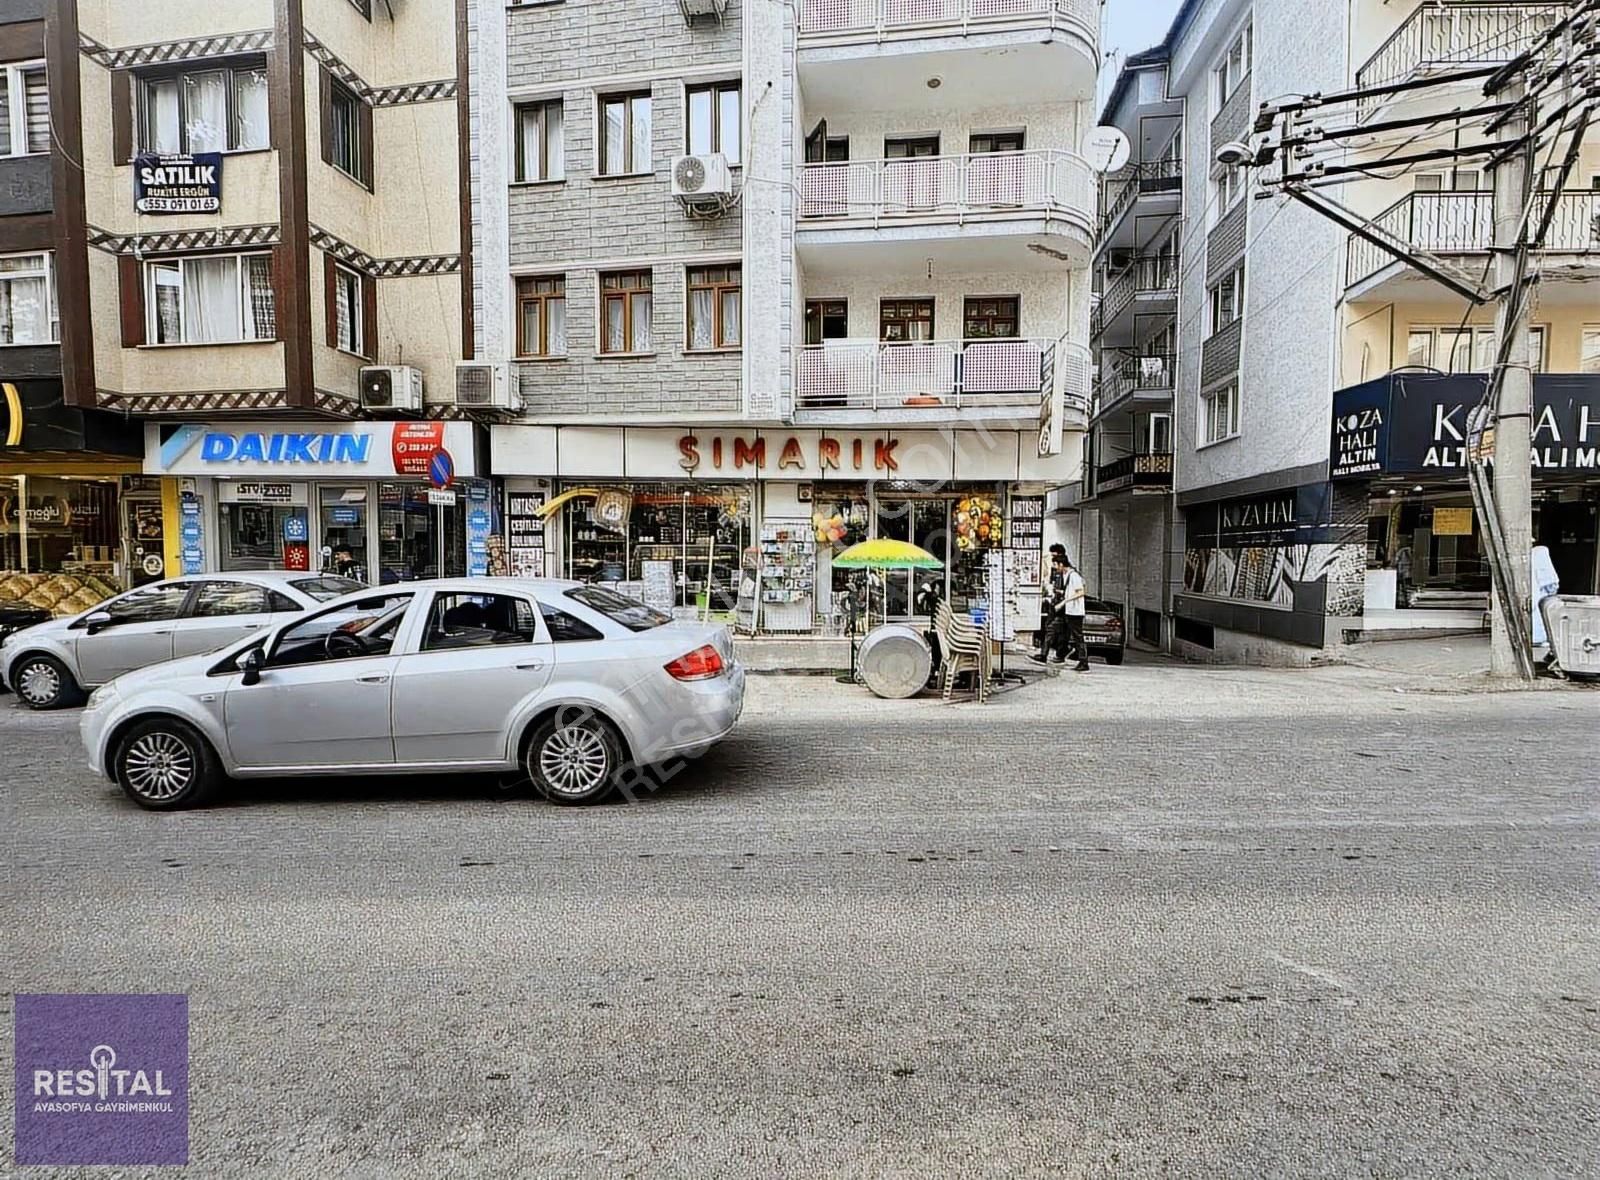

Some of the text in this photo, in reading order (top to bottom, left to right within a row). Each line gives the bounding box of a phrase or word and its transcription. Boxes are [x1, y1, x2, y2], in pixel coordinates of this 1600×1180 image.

[141, 166, 216, 185] SATILIK
[170, 200, 188, 209] 091
[190, 200, 201, 209] 01
[201, 433, 371, 464] DAIKIN
[1340, 429, 1377, 452] HALI
[679, 435, 899, 473] ŞIMARIK
[1339, 447, 1376, 465] ALTIN
